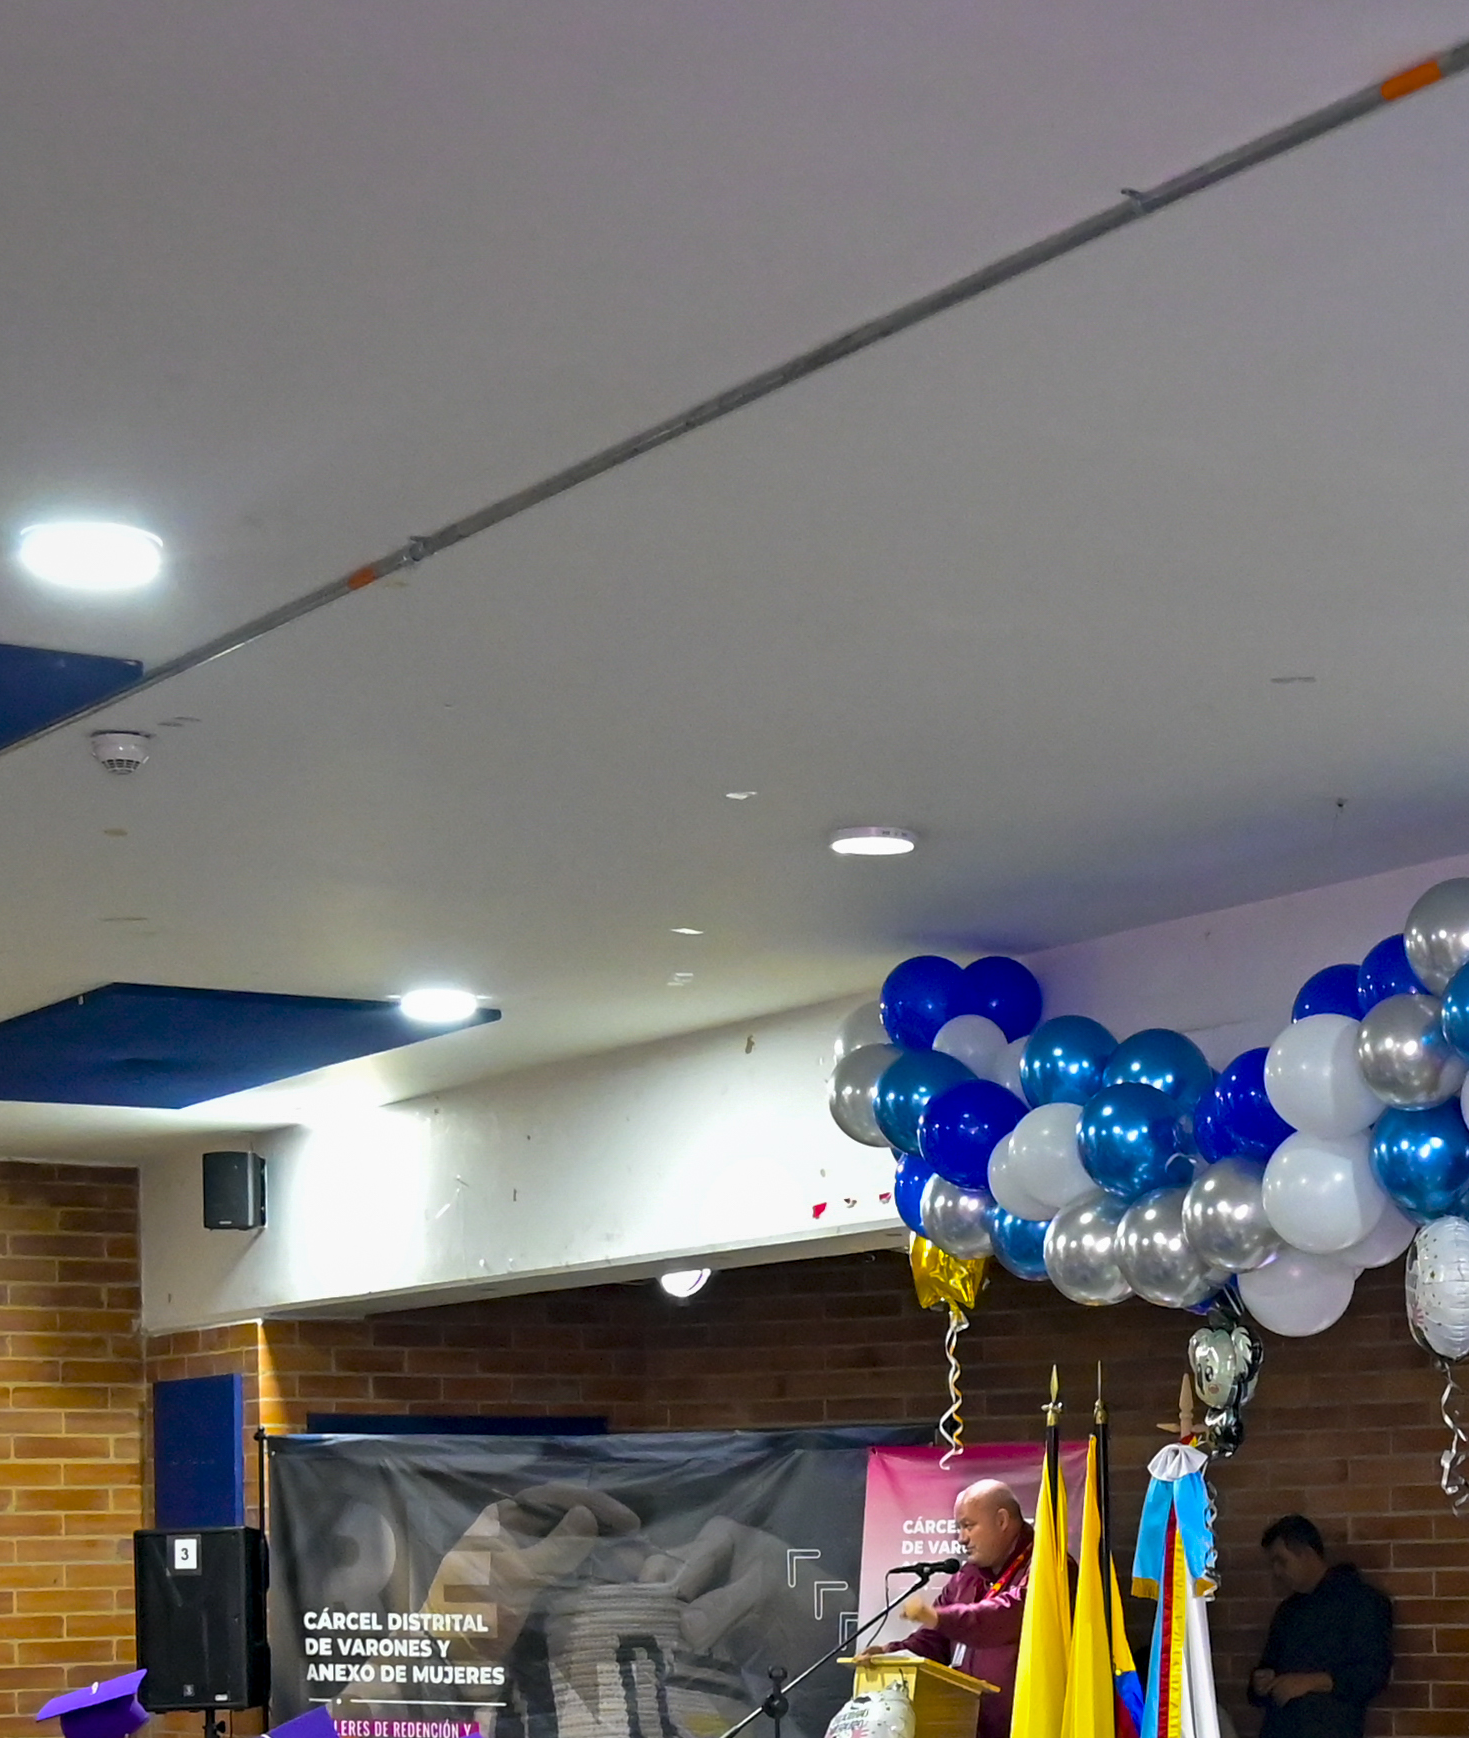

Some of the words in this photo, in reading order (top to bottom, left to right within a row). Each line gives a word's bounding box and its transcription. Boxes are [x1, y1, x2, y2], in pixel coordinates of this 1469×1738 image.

[181, 1547, 189, 1561] 3
[901, 1541, 924, 1555] DE
[303, 1607, 383, 1631] CÁRCEL
[387, 1612, 489, 1633] DISTRITAL
[304, 1637, 332, 1656] DE
[336, 1638, 433, 1658] VARONES
[436, 1640, 451, 1658] Y
[306, 1663, 375, 1682] ANEXO
[380, 1664, 407, 1684] DE
[412, 1665, 506, 1686] MUJERES
[333, 1719, 370, 1737] LERES
[374, 1721, 389, 1738] DE
[393, 1718, 459, 1738] REDENCIÓN
[463, 1723, 472, 1737] Y
